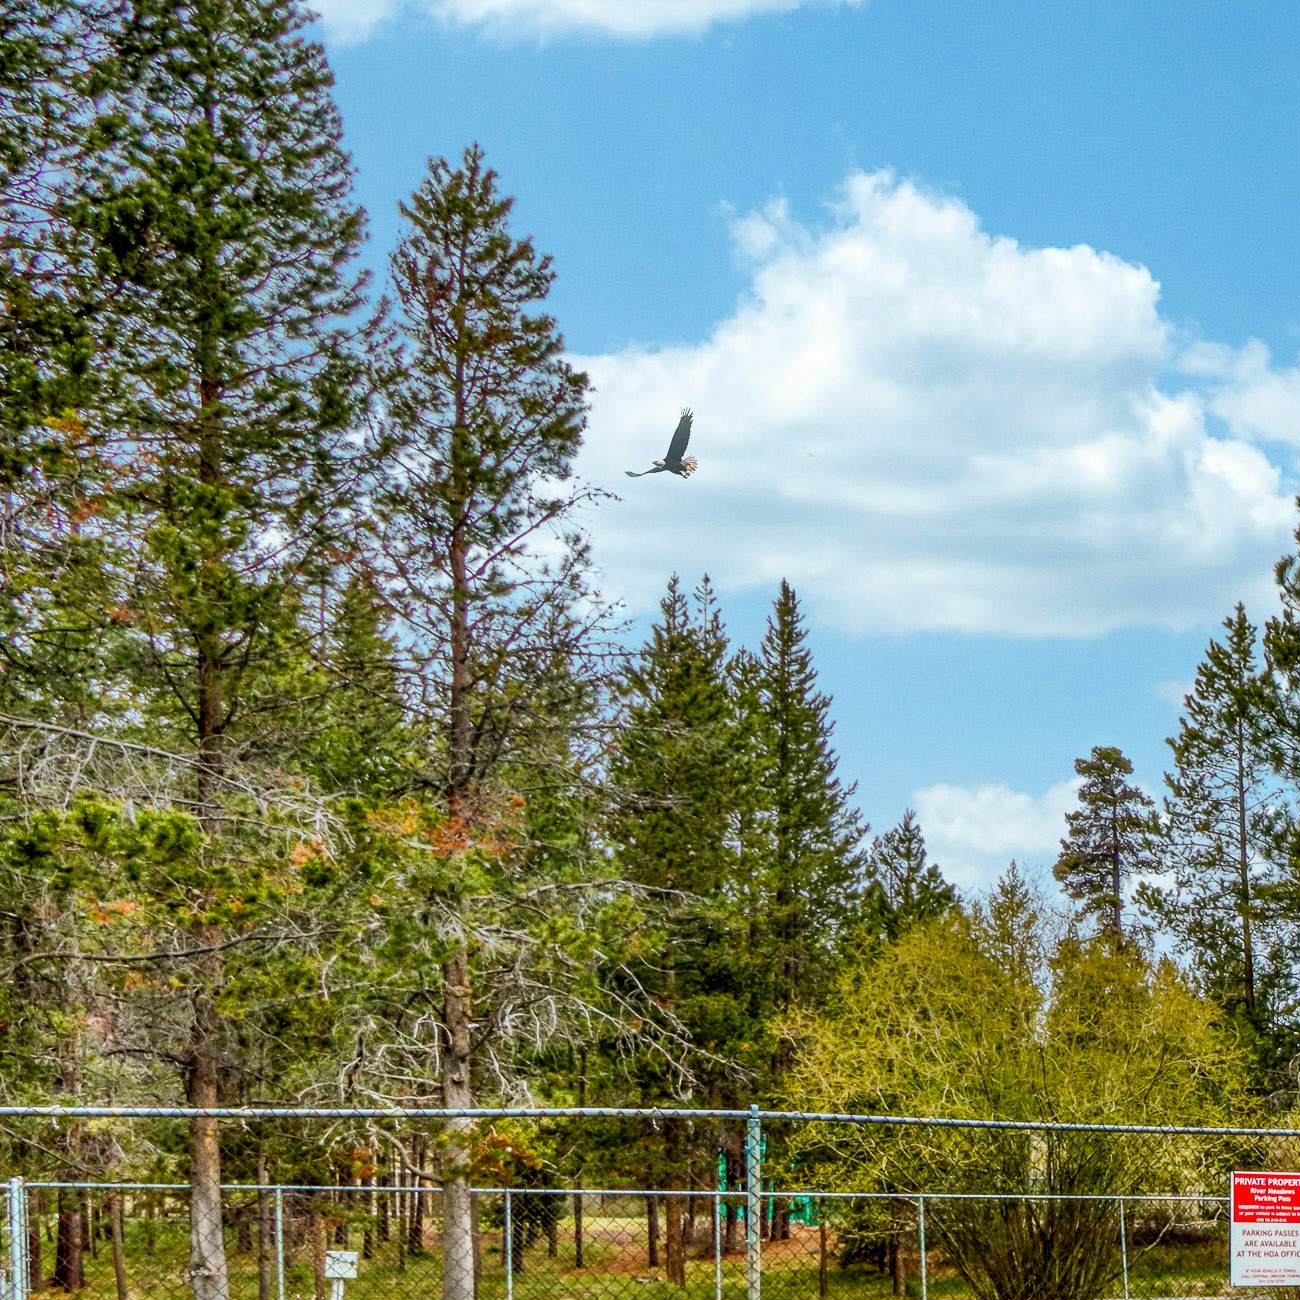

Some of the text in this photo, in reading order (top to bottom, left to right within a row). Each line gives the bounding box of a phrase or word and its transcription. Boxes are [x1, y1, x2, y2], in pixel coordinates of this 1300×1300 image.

[1235, 1178, 1266, 1186] PRIVATE
[1254, 1195, 1277, 1203] Parking
[1242, 1229, 1273, 1237] PARKING
